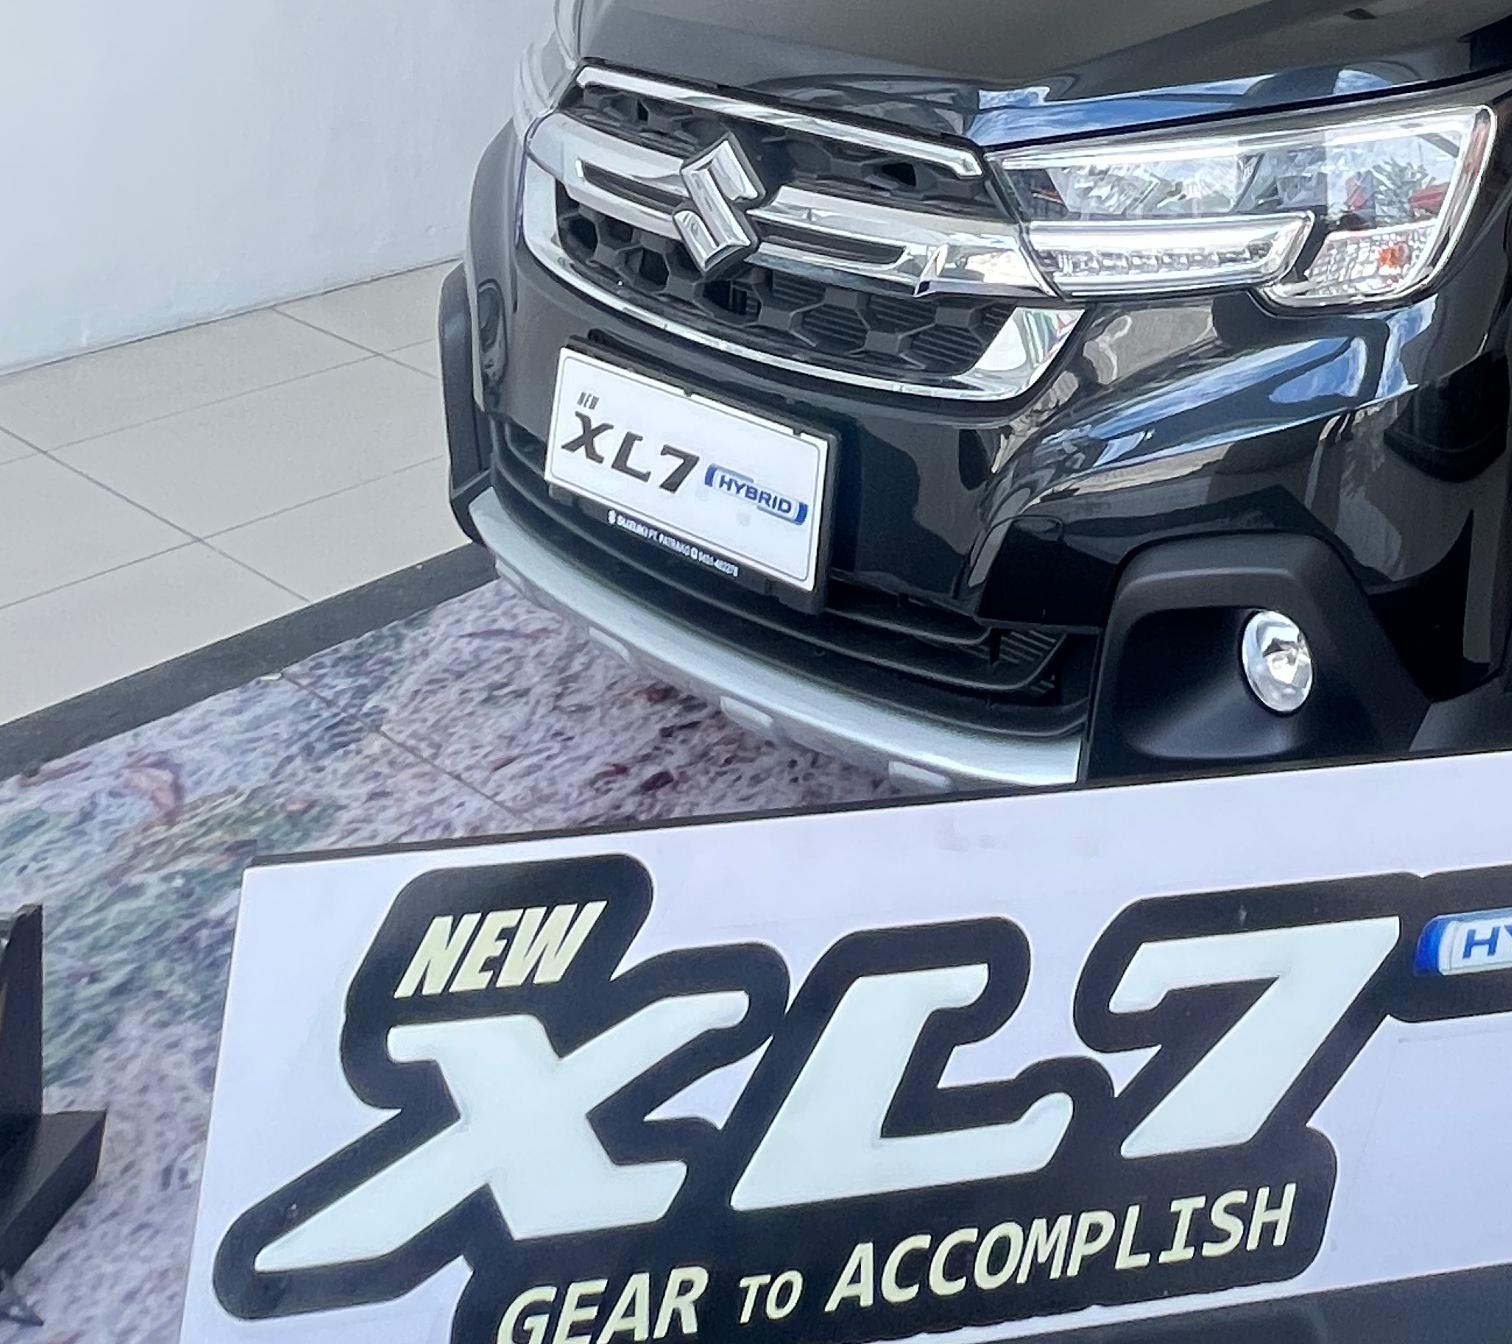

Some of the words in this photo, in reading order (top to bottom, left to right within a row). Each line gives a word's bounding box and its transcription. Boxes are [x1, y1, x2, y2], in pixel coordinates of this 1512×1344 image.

[561, 411, 700, 494] XL7
[719, 474, 793, 515] HYBRID
[394, 900, 607, 999] NEW
[254, 915, 1400, 1273] XL7
[496, 1267, 708, 1344] GEAR
[738, 1269, 803, 1324] TO
[825, 1183, 1297, 1312] ACCOMPLISH
